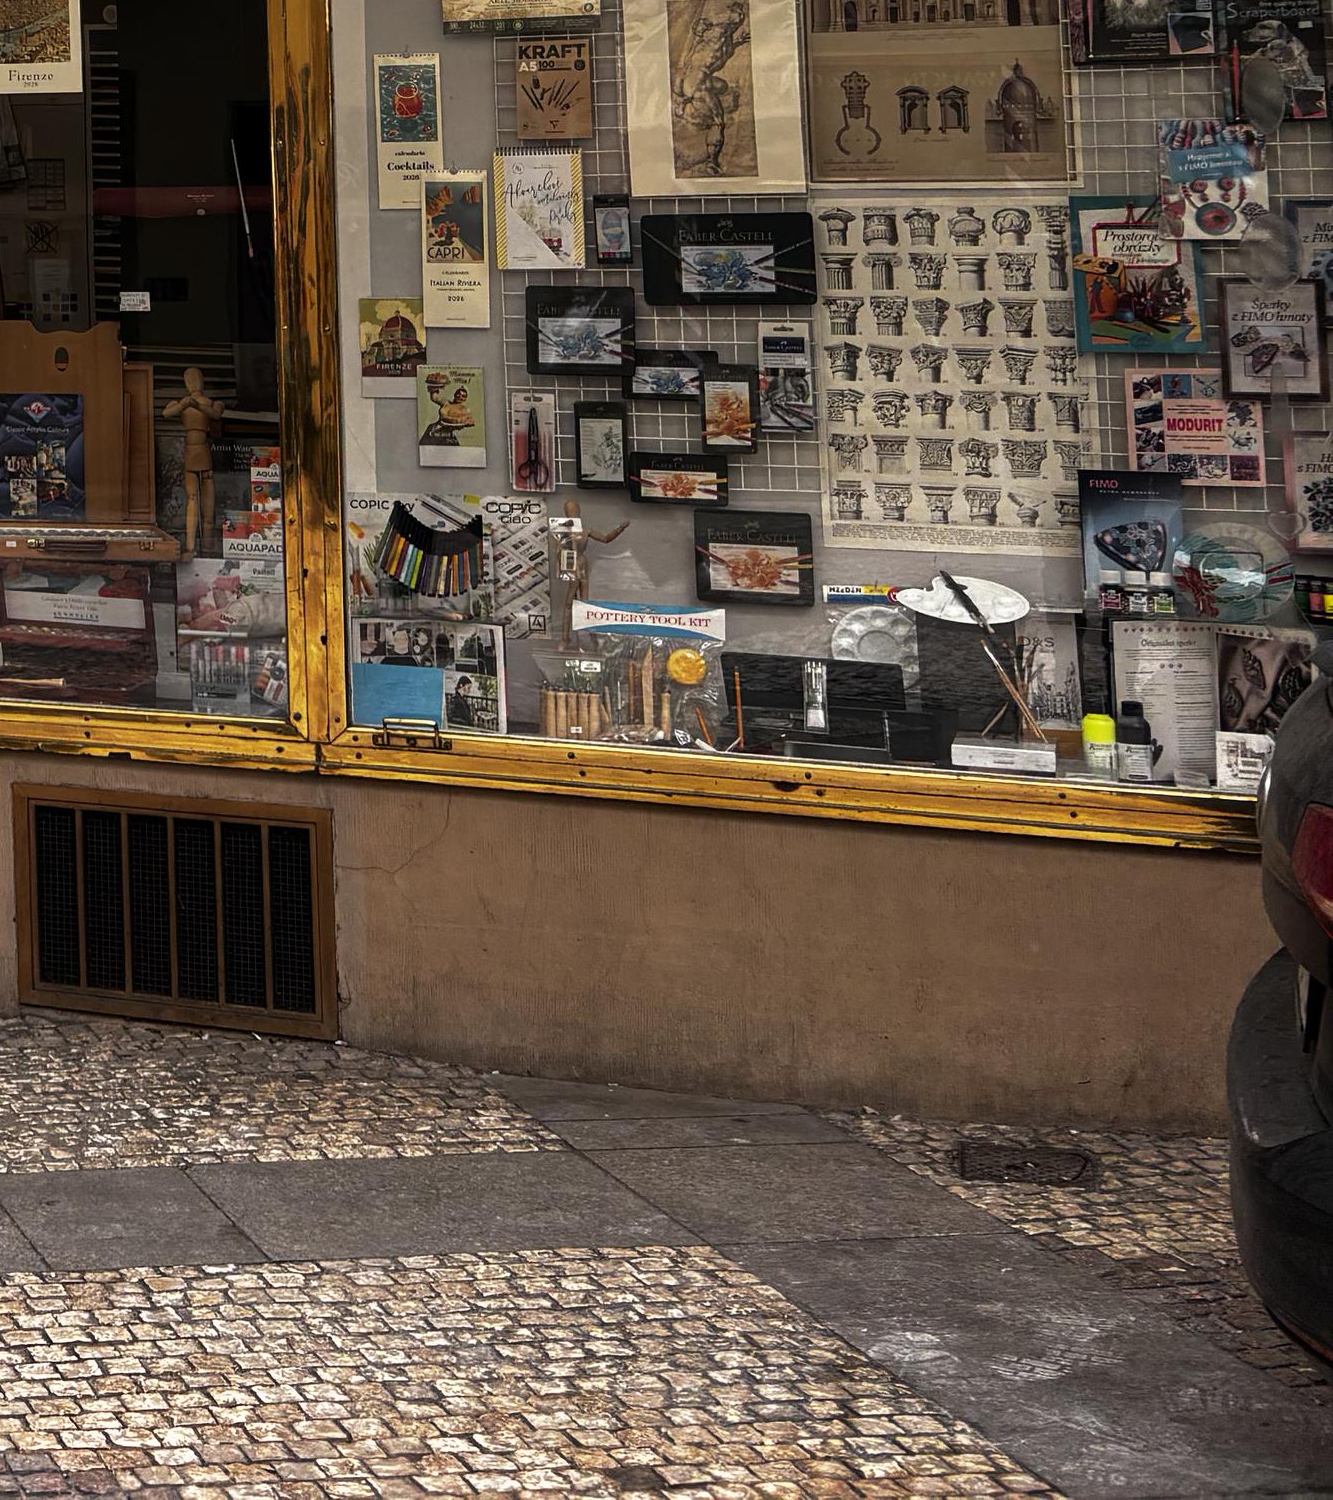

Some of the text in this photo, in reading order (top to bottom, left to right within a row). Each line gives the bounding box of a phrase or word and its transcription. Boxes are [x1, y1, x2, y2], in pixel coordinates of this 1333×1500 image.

[1226, 2, 1321, 19] Scraperboard
[518, 43, 586, 60] KRAFT
[519, 59, 555, 72] A5 100
[8, 70, 54, 81] Firenze
[387, 161, 435, 172] Cocktails
[679, 228, 774, 244] FABER-CASTELL
[427, 246, 465, 260] CAPRI
[1113, 242, 1162, 259] obrázky
[1251, 297, 1292, 315] Šperky
[1242, 311, 1274, 321] FIMO
[1276, 311, 1314, 325] hmoty
[376, 363, 413, 371] FIRENZE
[1166, 417, 1225, 432] MODURIT
[1089, 479, 1120, 489] FIMO
[350, 499, 390, 510] COPIC
[484, 502, 543, 515] COPIC
[586, 610, 711, 628] POTTERY TOOL KIT
